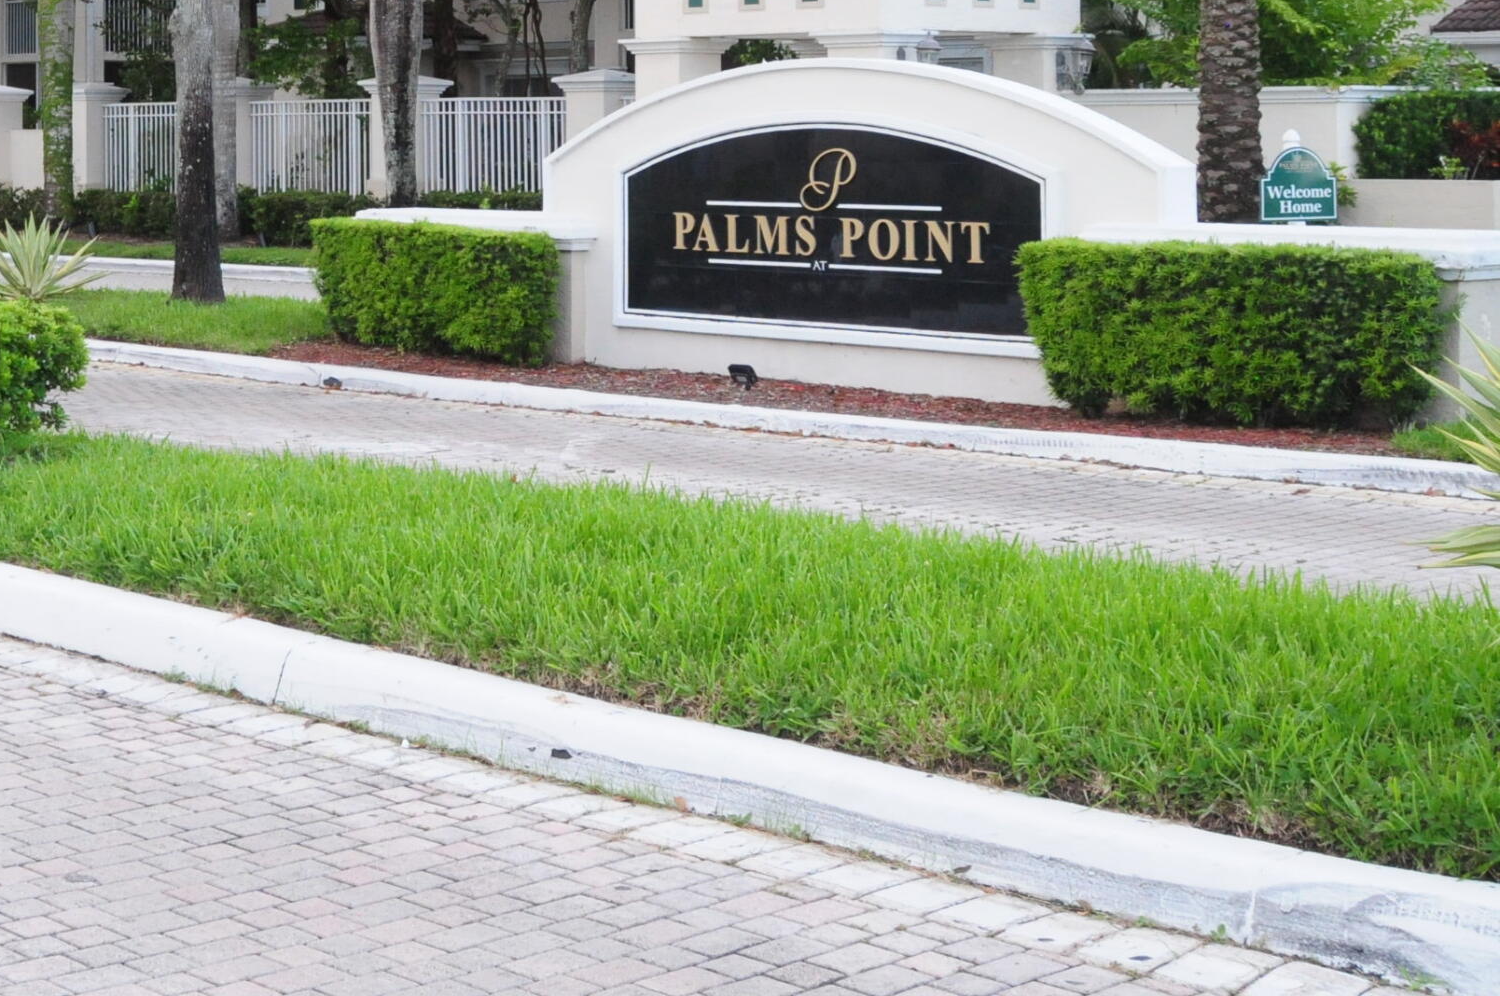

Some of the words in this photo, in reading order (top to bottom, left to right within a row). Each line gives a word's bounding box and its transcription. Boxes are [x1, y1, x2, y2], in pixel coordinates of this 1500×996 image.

[1266, 184, 1332, 199] Welcome
[1279, 199, 1322, 214] Home
[672, 211, 817, 257] PALMS
[838, 217, 991, 264] POINT
[812, 259, 828, 271] AT
